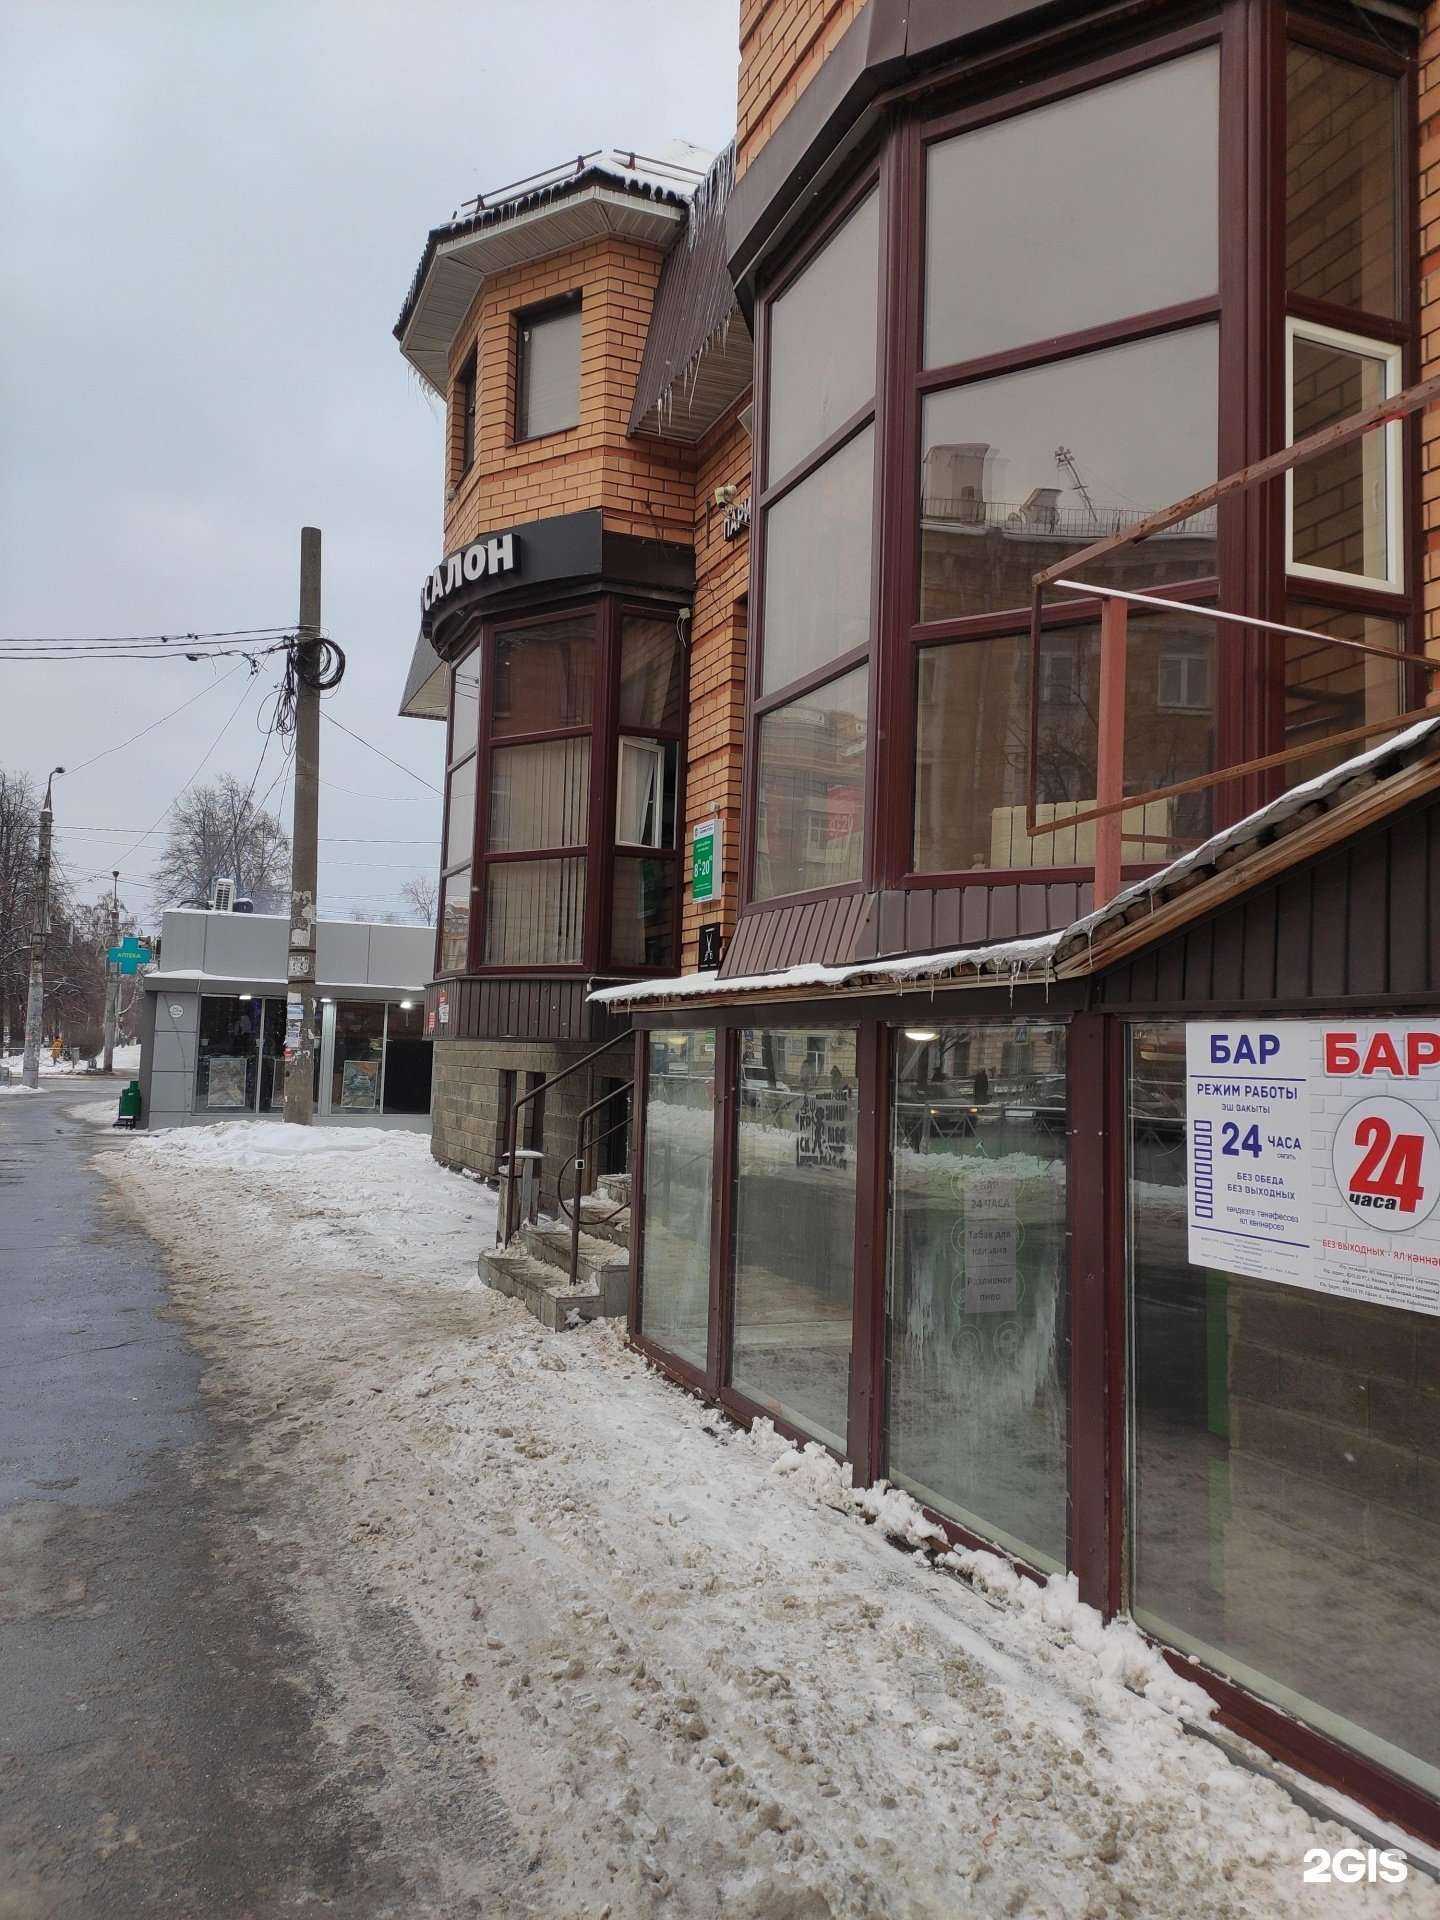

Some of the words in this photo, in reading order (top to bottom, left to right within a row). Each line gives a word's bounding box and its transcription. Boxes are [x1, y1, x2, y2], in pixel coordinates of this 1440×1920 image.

[424, 533, 514, 611] САЛОН
[1210, 1034, 1281, 1065] БАР
[1325, 1032, 1440, 1077] БАР
[1197, 1083, 1240, 1096] РЕЖИМ
[1244, 1085, 1297, 1100] РАБОТЫ
[1222, 1121, 1262, 1158] 24
[1267, 1136, 1302, 1150] ЧАСА
[1349, 1116, 1424, 1213] 24
[1237, 1172, 1252, 1182] БЕЗ
[1255, 1174, 1284, 1186] ОБЕДА
[1227, 1184, 1243, 1193] БЕЗ
[1245, 1186, 1296, 1201] ВЫХОДНЫХ
[1349, 1193, 1397, 1211] часа
[1322, 1240, 1336, 1249] БЕЗ
[1338, 1242, 1385, 1257] ВЫХОДНЫХ
